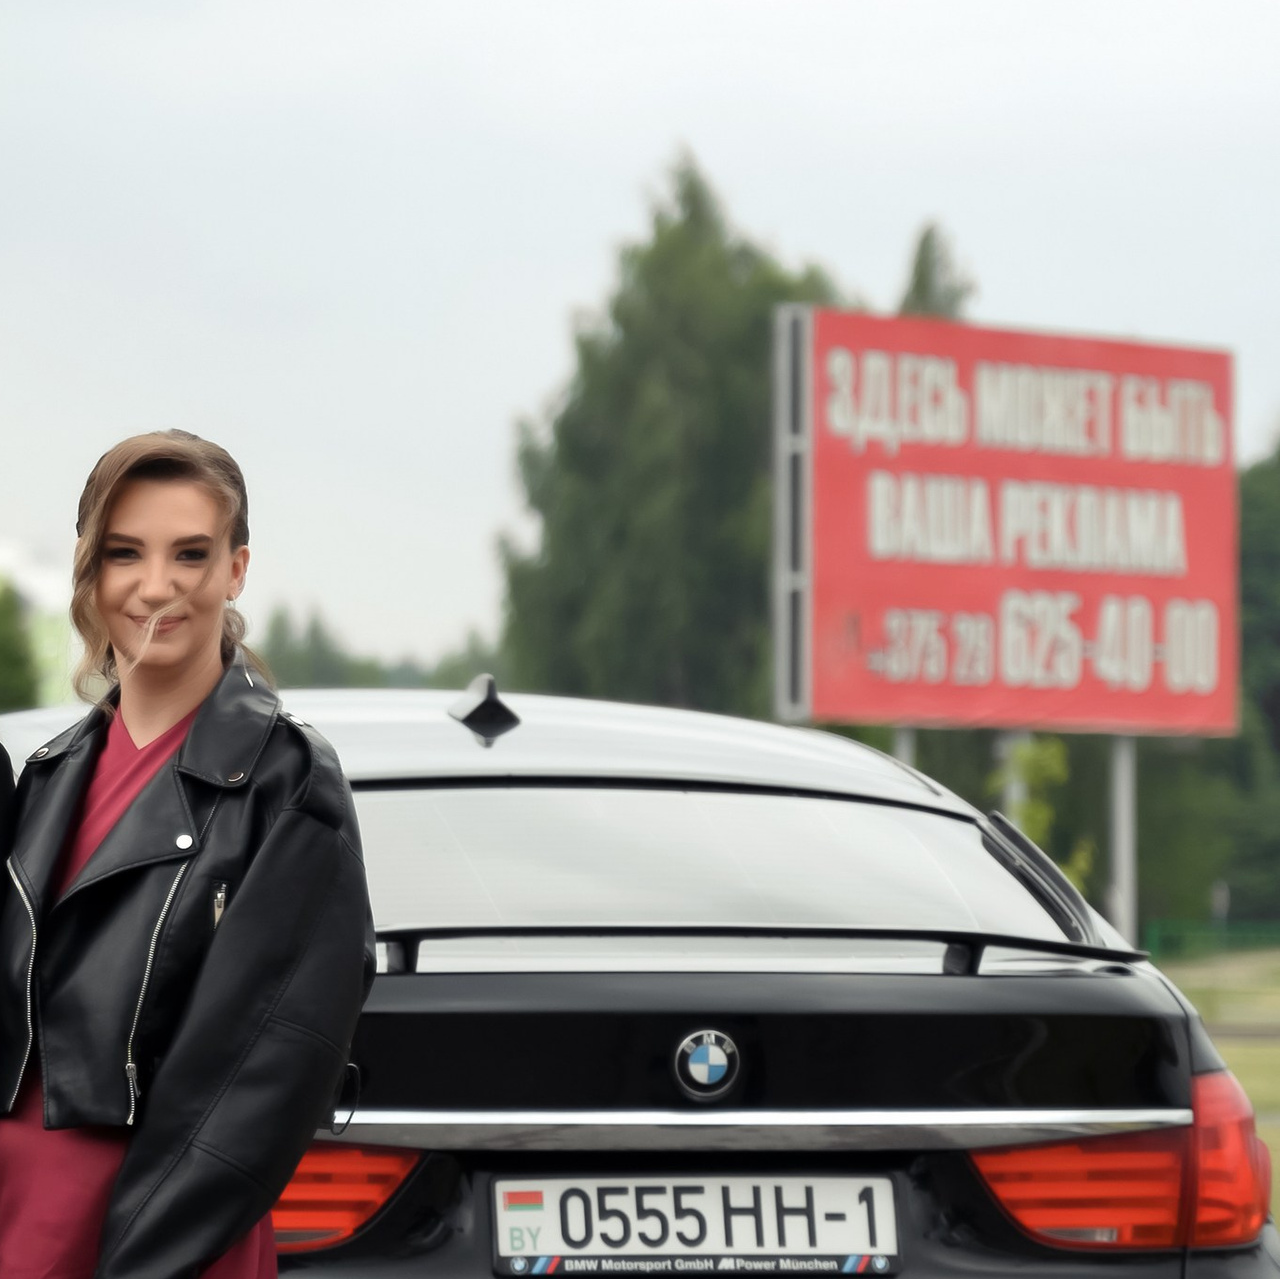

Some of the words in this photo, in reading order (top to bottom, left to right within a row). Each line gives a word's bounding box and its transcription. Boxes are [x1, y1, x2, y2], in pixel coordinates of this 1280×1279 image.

[826, 346, 968, 455] ЗДЕСЬ
[974, 360, 1113, 457] МОЖЕТ
[1122, 374, 1224, 467] БЫТЬ
[867, 469, 995, 566] ВАША
[1000, 478, 1187, 576] РЕКЛАМА
[509, 1226, 541, 1251] BY
[564, 1259, 599, 1271] BMW
[601, 1259, 672, 1273] Motorsport
[674, 1258, 714, 1271] GmbH
[779, 1257, 838, 1271] München
